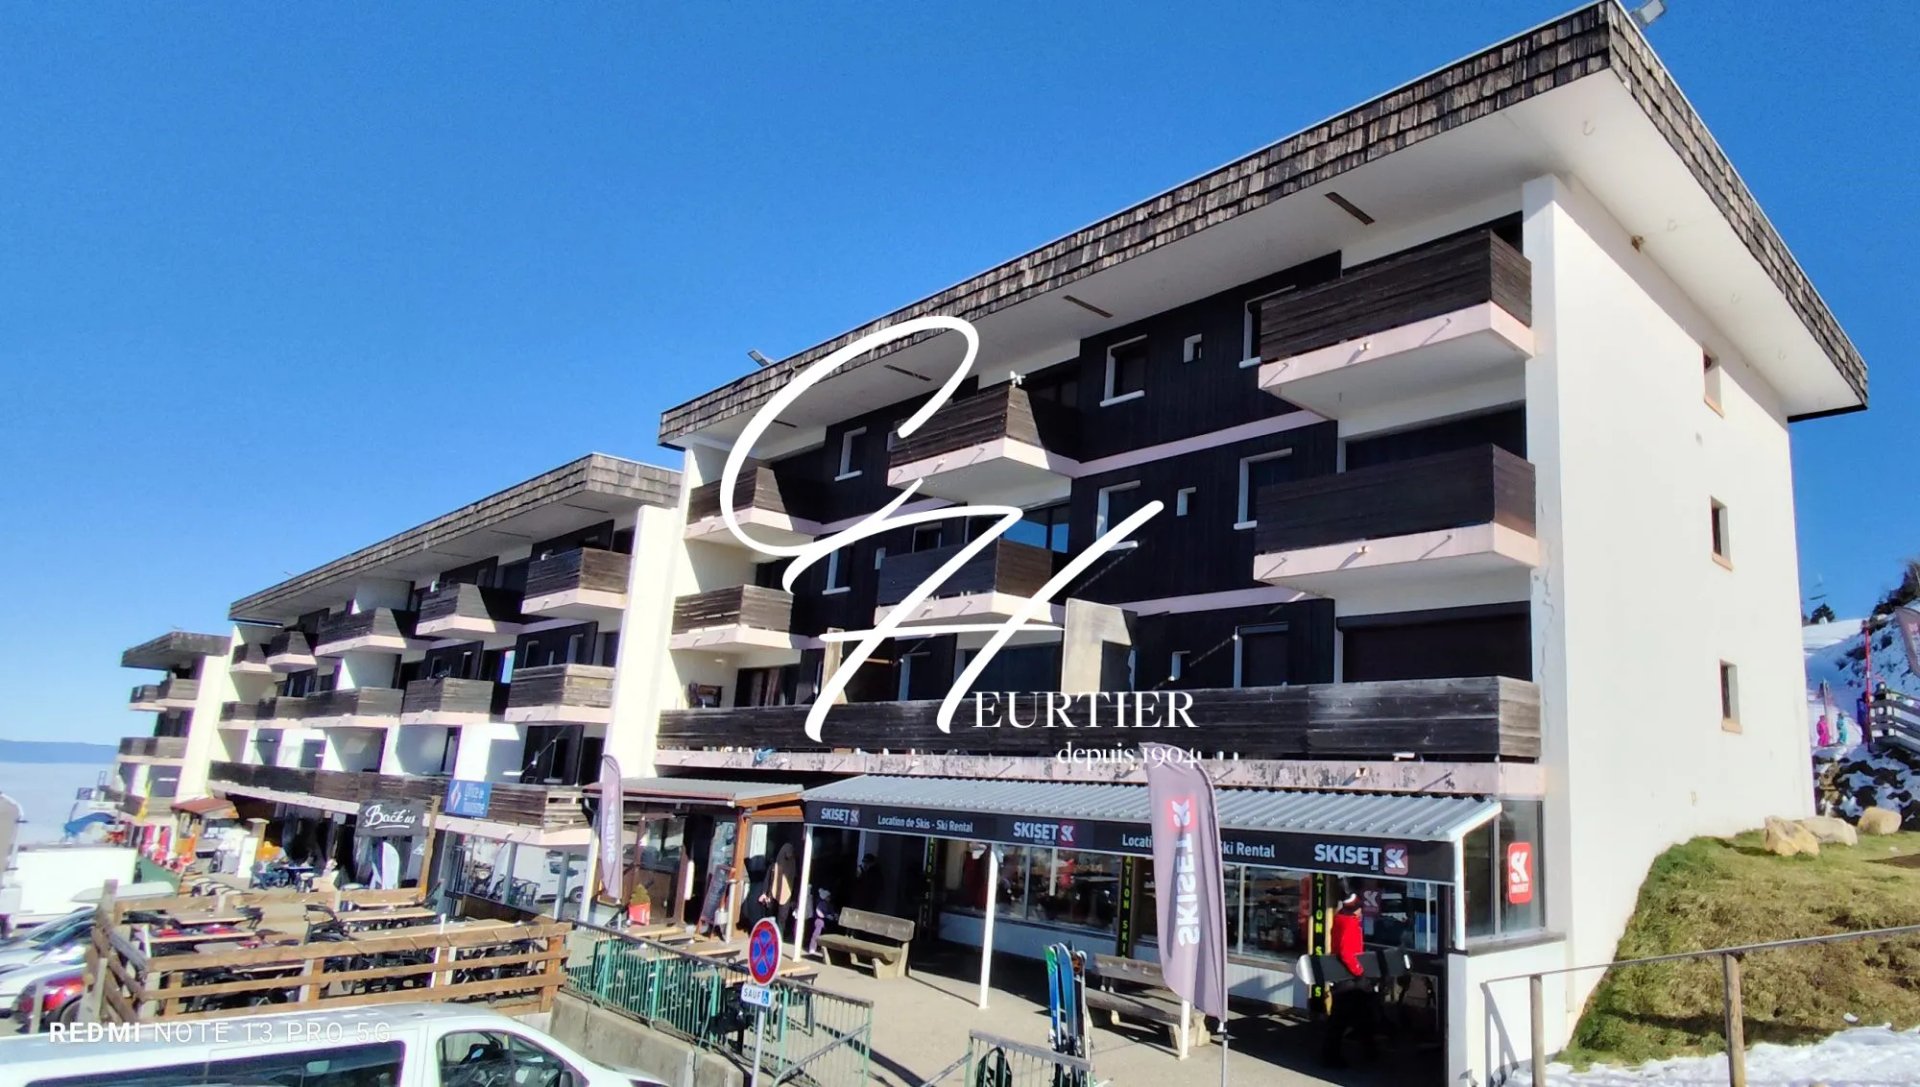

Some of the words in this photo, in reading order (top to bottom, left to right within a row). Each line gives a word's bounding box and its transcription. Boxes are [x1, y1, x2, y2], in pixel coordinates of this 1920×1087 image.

[821, 807, 850, 821] SKISET
[877, 814, 905, 827] Location
[905, 817, 915, 828] de
[915, 818, 930, 829] Skis
[936, 820, 948, 831] Ski
[949, 820, 973, 833] Rental
[1013, 821, 1059, 840] SKISET
[1122, 833, 1152, 848] Locati
[1236, 842, 1276, 858] Rental
[1314, 843, 1382, 866] SKISET
[1123, 856, 1131, 909] ATION
[1315, 872, 1323, 933] ATION
[743, 987, 761, 1000] SAUF
